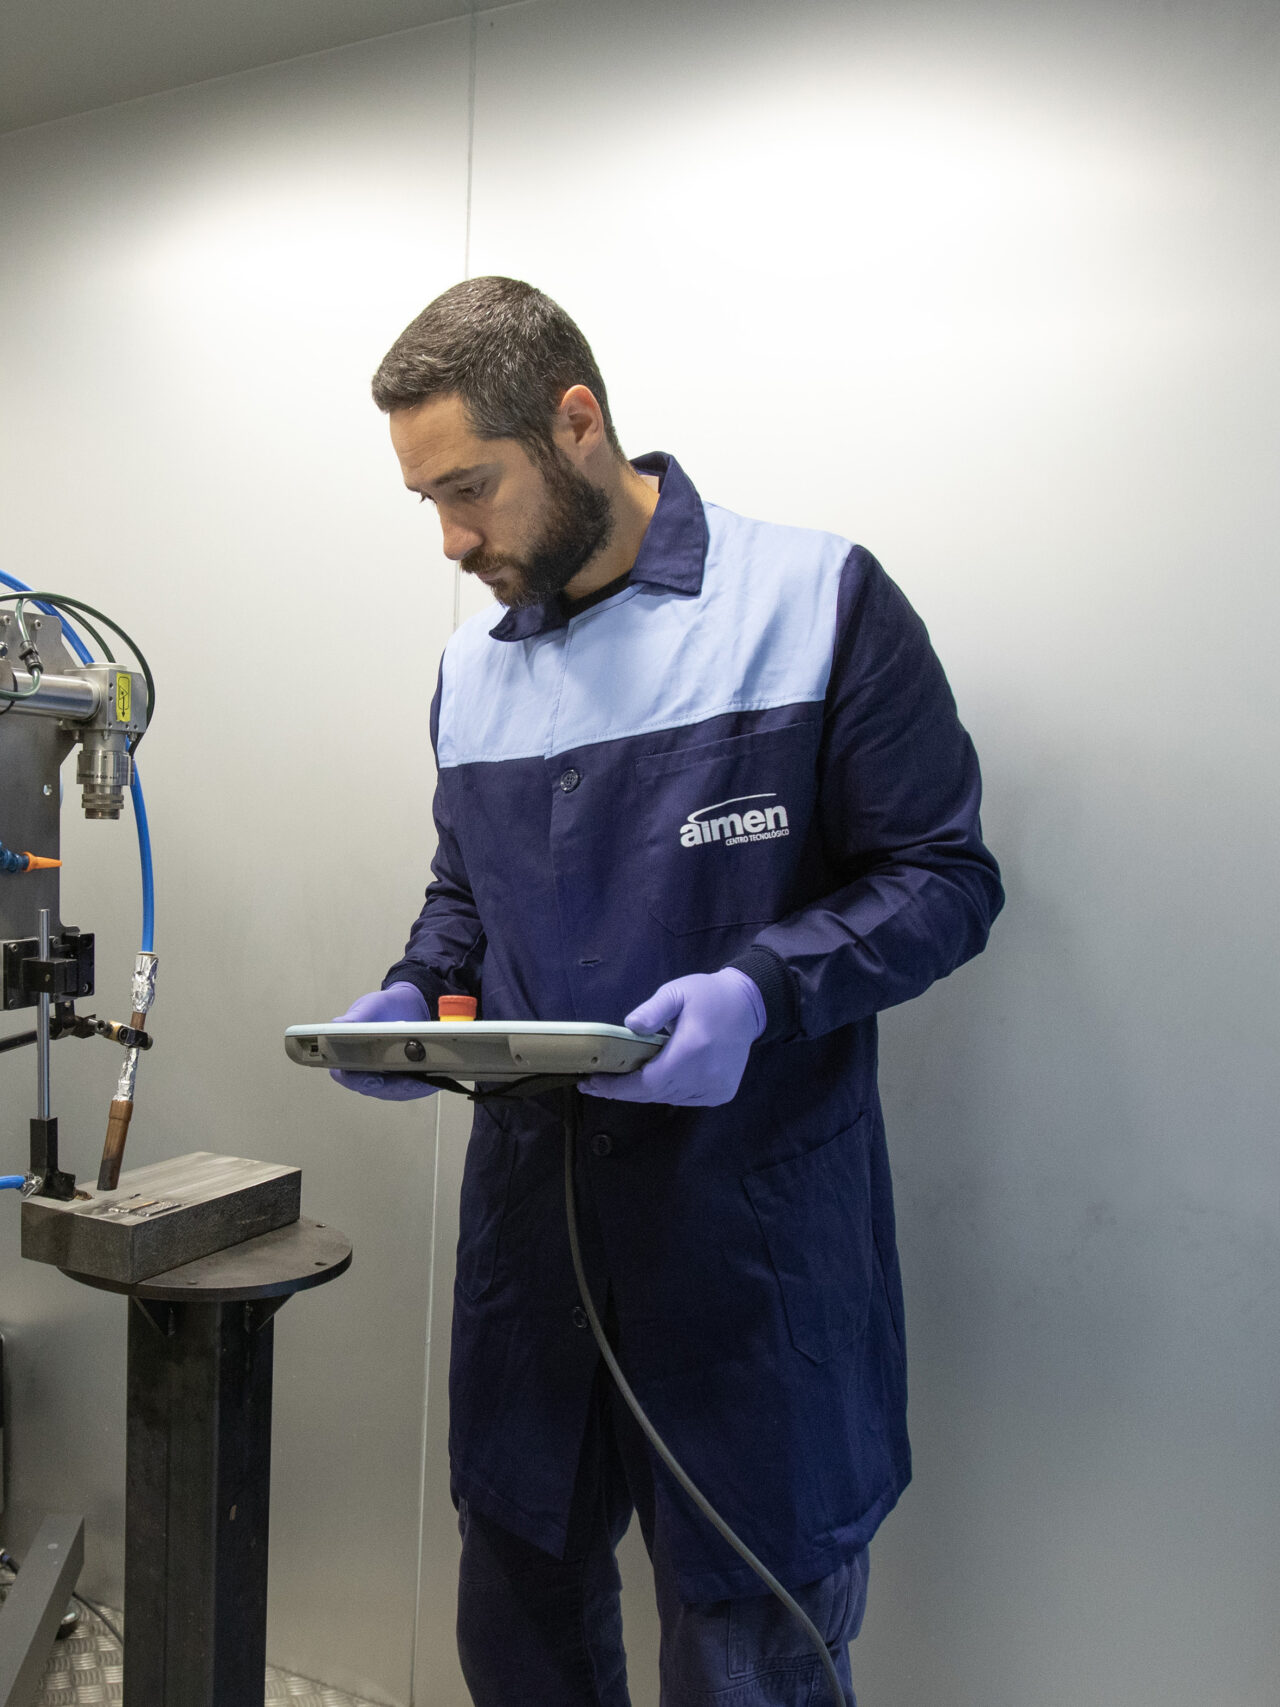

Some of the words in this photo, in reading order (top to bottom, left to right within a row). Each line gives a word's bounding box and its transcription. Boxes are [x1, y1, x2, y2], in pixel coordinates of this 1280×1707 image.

[679, 804, 789, 848] aimen
[725, 835, 749, 847] CENTRO
[749, 828, 790, 843] TECNOLÓGICO
